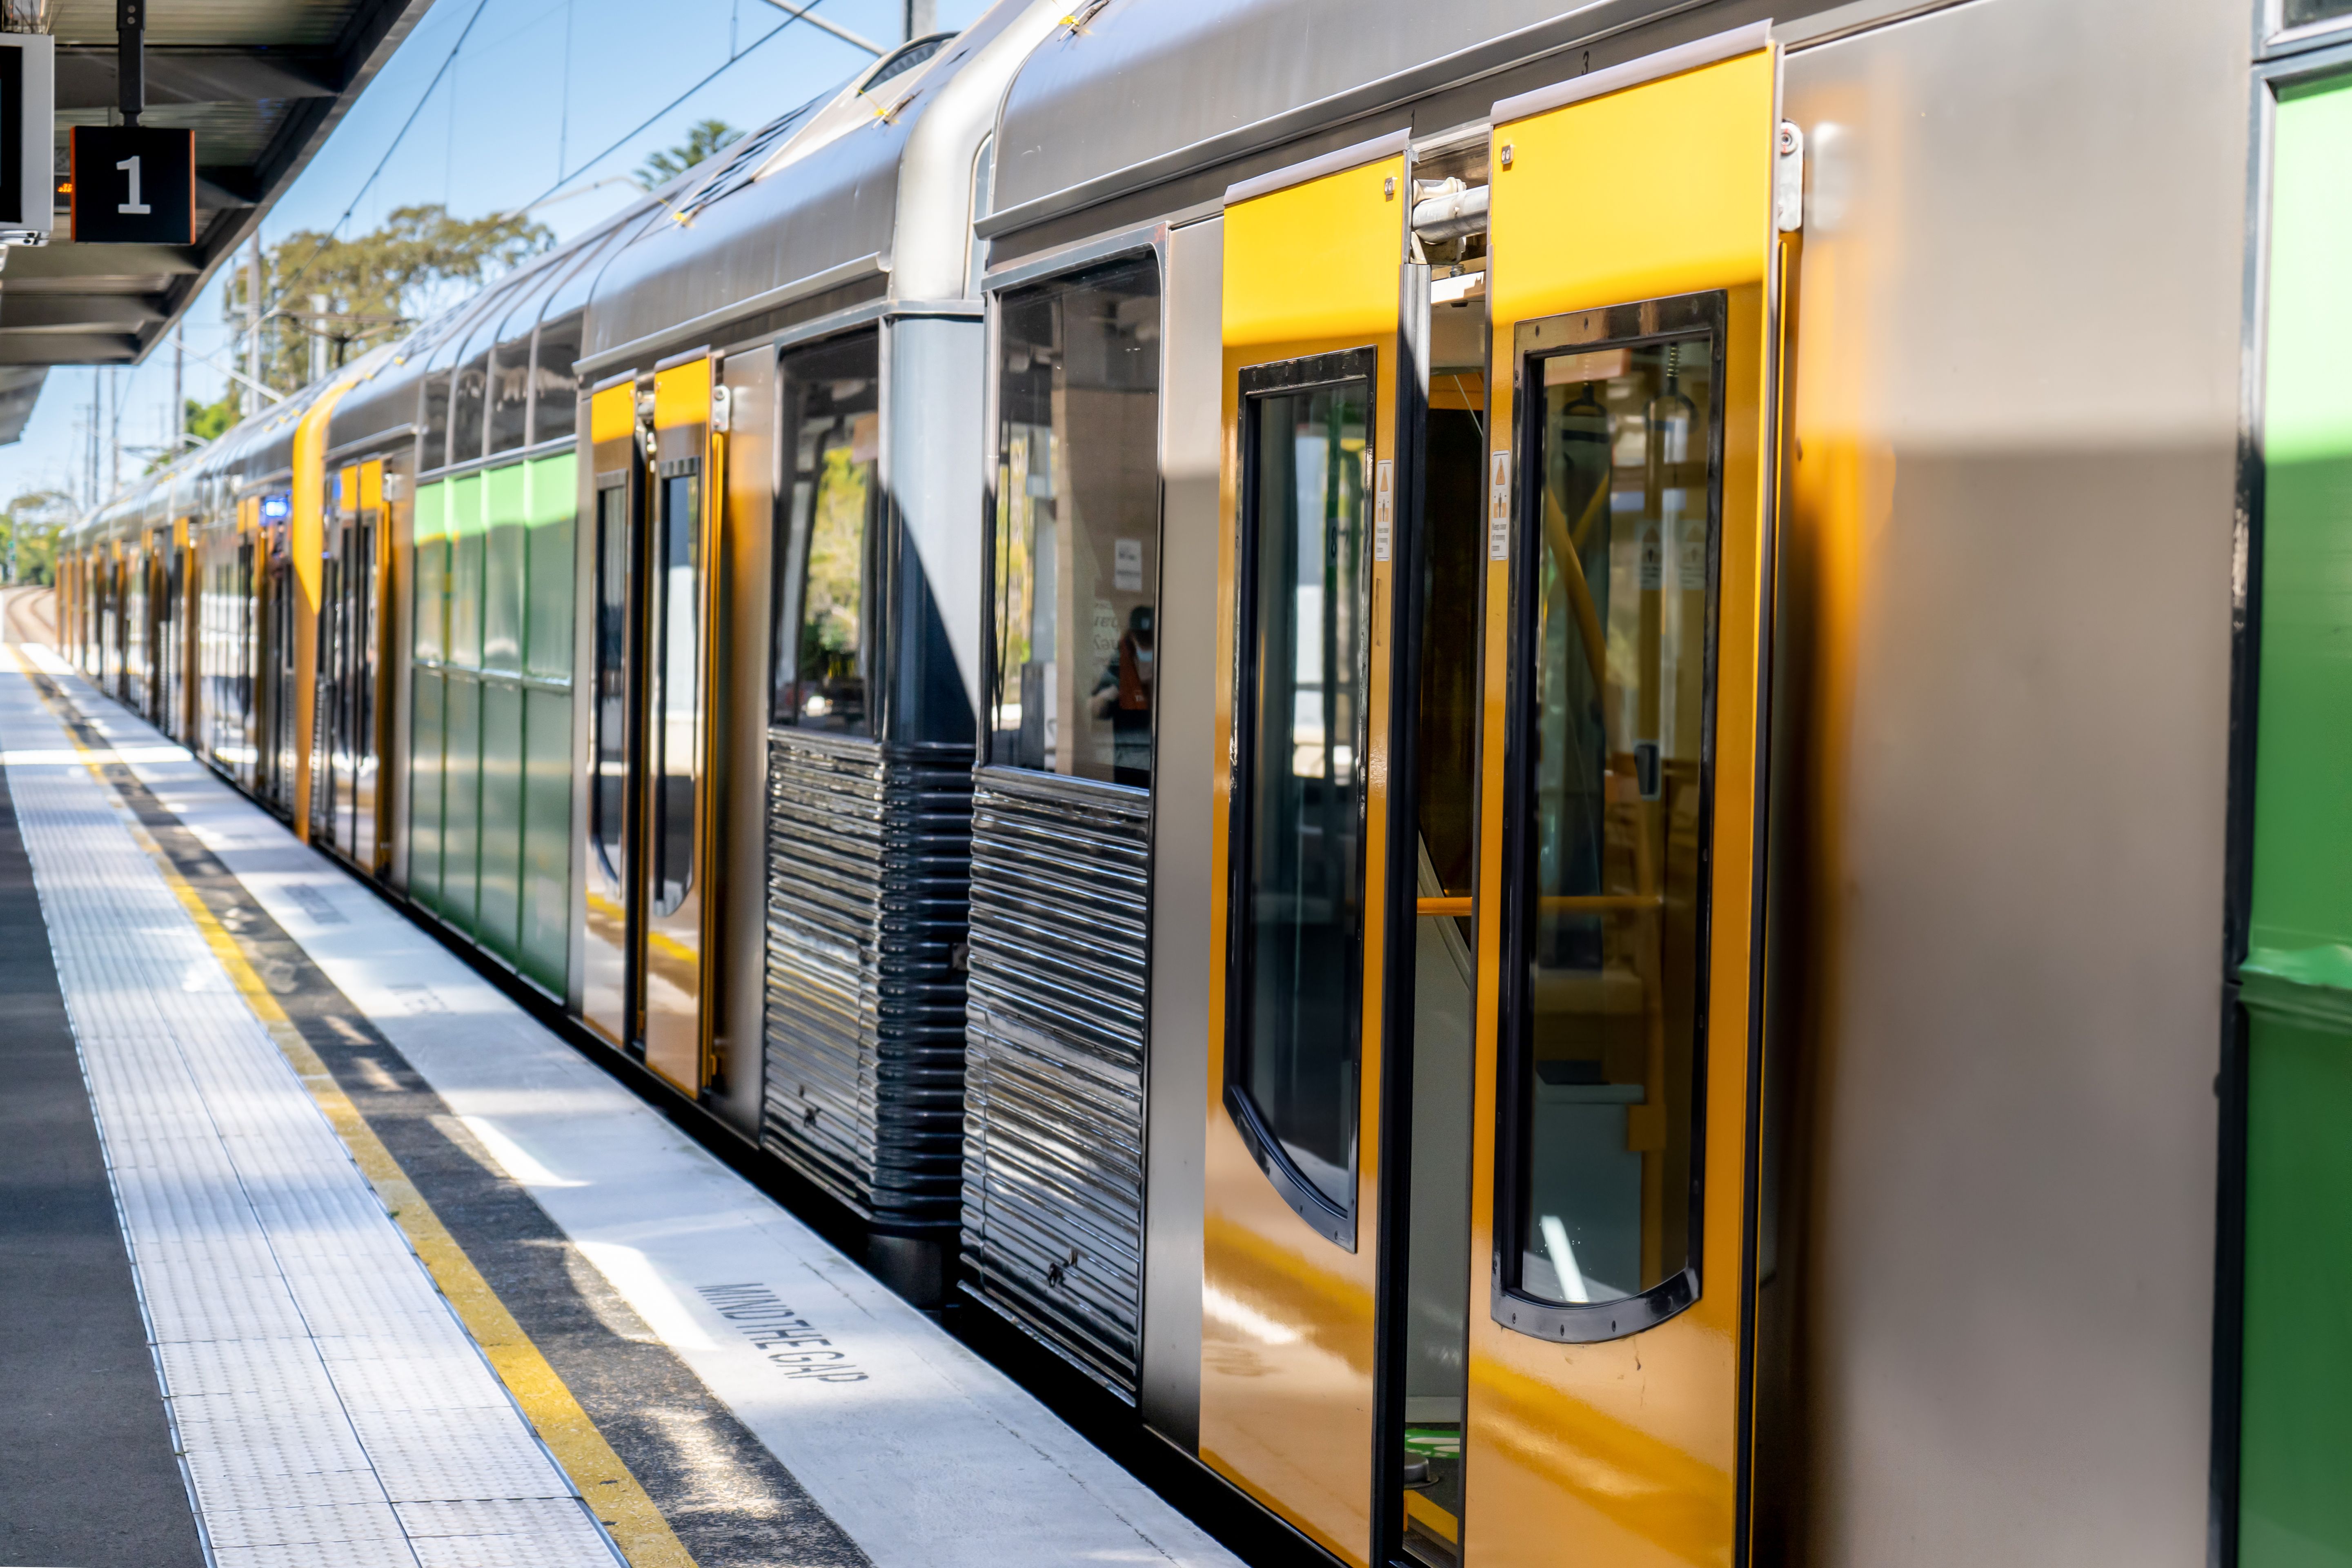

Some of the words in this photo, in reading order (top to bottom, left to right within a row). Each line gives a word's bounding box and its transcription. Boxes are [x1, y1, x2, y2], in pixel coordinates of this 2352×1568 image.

[116, 156, 151, 214] 1
[694, 1283, 794, 1319] MIND
[736, 1319, 832, 1349] THE
[768, 1352, 869, 1382] GAP
